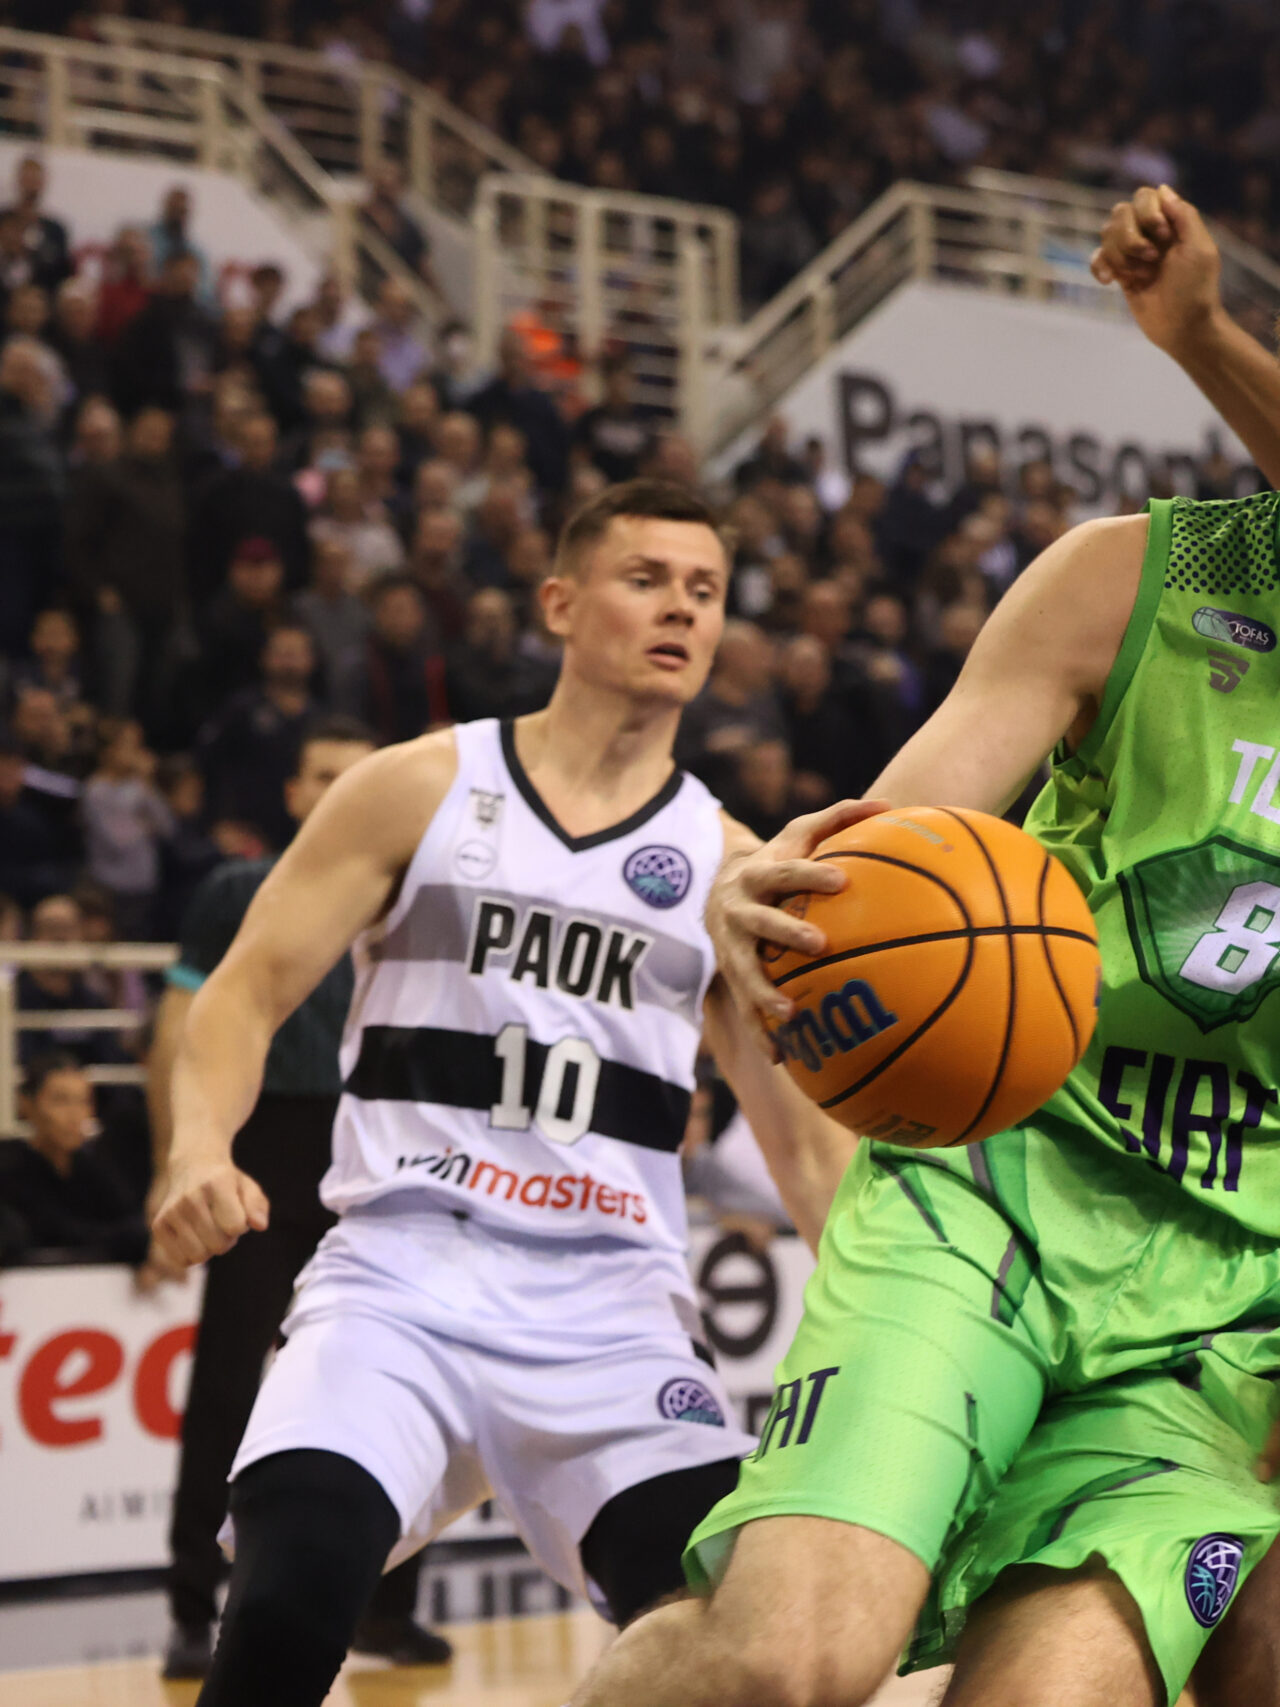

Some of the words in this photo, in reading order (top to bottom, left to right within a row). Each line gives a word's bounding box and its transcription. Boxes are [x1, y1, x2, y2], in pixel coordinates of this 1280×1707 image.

[467, 896, 654, 1011] PAOK
[489, 1022, 602, 1146] 10
[1098, 1045, 1280, 1193] FIAT
